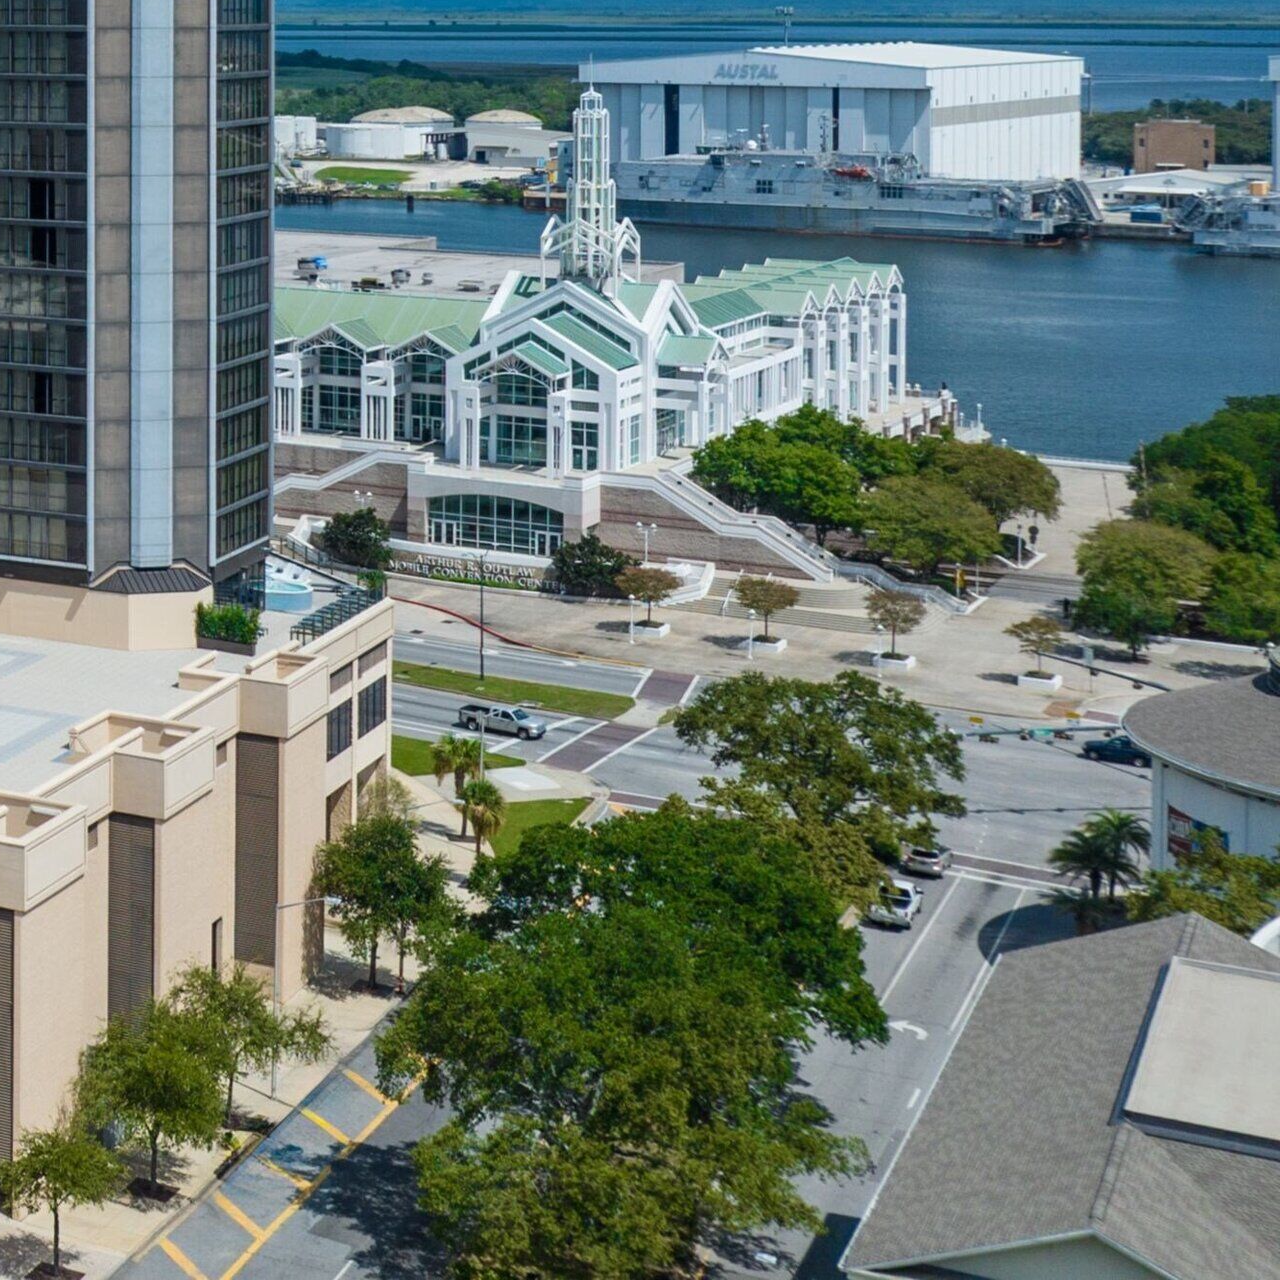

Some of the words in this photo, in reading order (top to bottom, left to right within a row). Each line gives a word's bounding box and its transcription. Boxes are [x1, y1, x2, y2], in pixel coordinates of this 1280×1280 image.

[714, 64, 778, 80] AUSTAL
[389, 559, 430, 575] MOBILE
[433, 566, 513, 584] CONVENTION
[518, 577, 567, 592] CENTER
[415, 554, 462, 569] ARTHUR
[483, 563, 536, 577] OUTLAW
